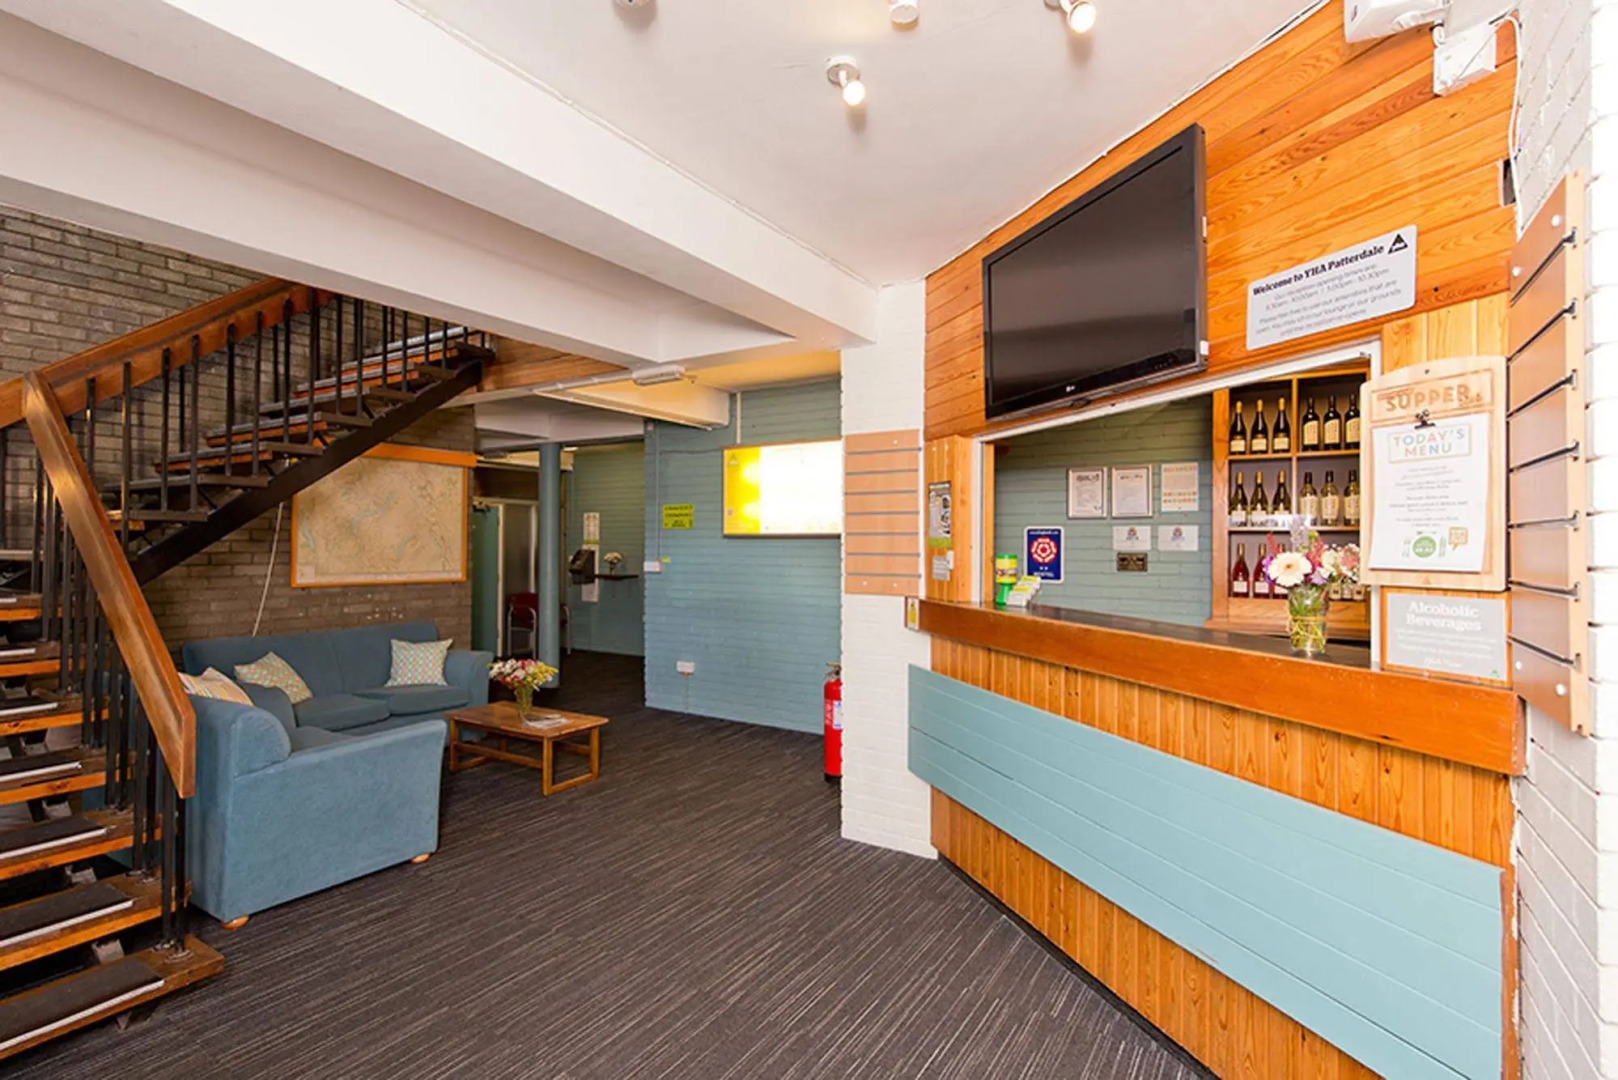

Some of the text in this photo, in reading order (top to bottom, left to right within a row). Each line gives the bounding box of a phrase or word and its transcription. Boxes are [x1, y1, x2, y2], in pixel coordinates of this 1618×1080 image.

[1253, 245, 1384, 296] Welcome to YHA Patterdale
[1382, 384, 1470, 412] SUPPER
[1393, 428, 1465, 447] TODAY'S
[1404, 442, 1452, 458] MENU
[1408, 601, 1479, 618] Alcoholic
[1406, 613, 1481, 632] Beverages
